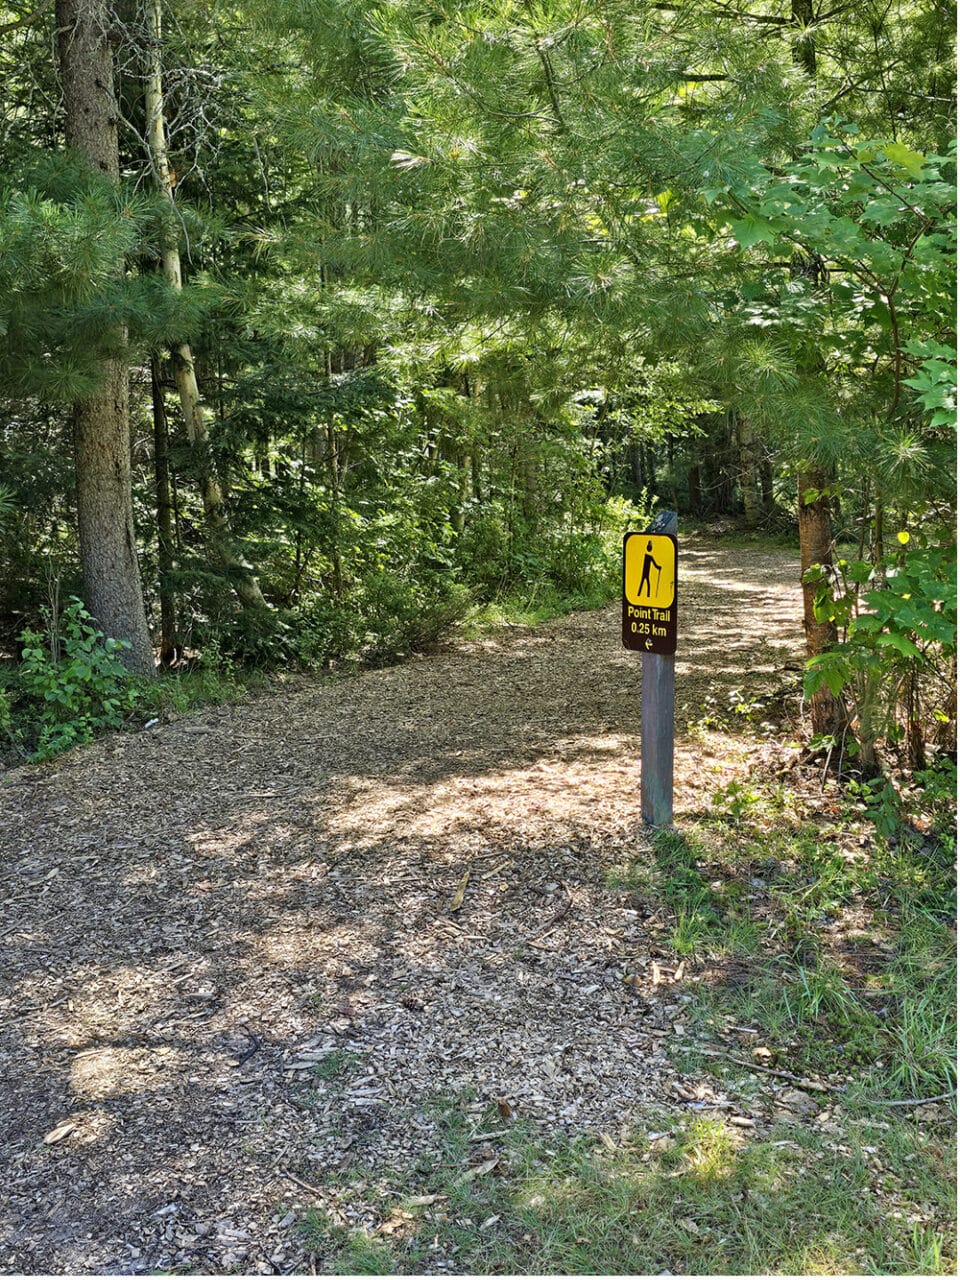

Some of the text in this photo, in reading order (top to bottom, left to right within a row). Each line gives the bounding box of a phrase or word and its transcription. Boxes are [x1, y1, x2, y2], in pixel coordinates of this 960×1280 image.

[628, 606, 670, 622] Point Trail
[631, 622, 667, 637] 0.25 km
